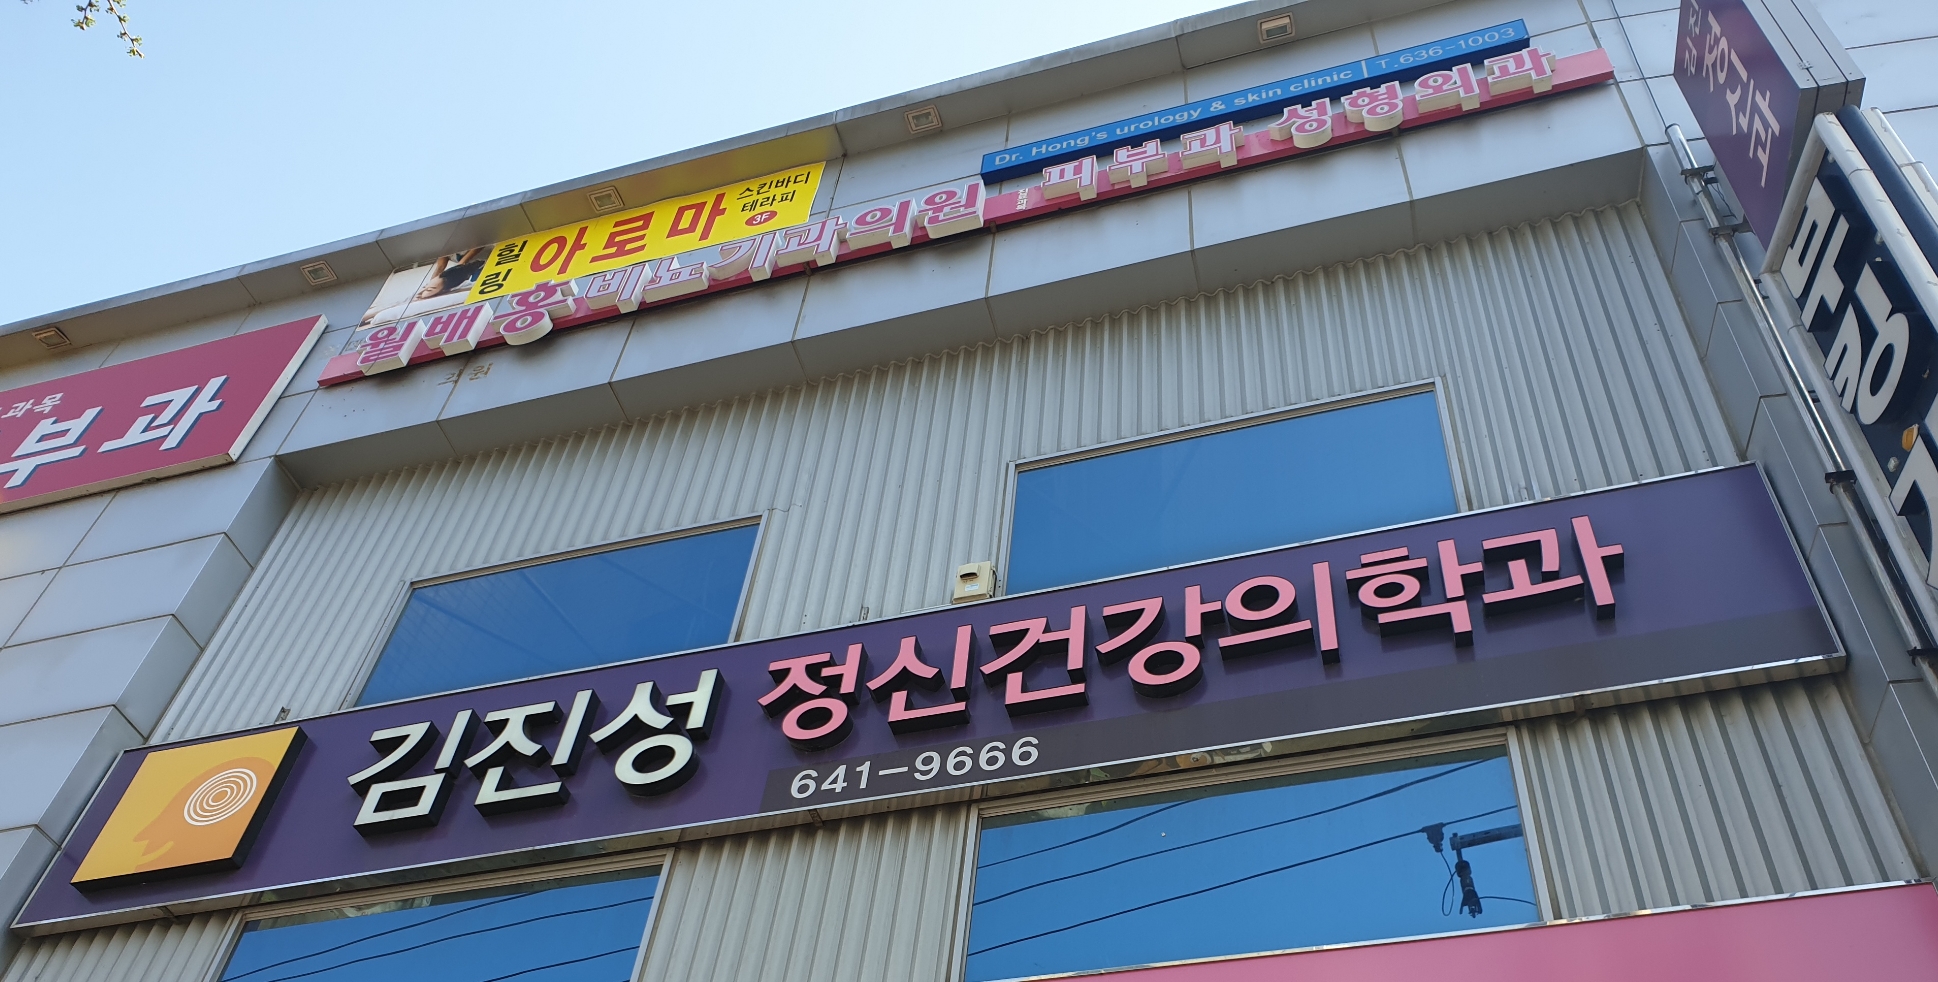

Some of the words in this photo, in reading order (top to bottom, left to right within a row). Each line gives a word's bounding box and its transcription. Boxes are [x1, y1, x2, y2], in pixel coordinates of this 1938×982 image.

[994, 151, 1023, 167] Dr.
[1031, 130, 1108, 157] Hong's
[1115, 106, 1203, 135] urology
[1209, 100, 1226, 113] &
[1233, 86, 1282, 107] skin
[1289, 69, 1353, 94] clinic
[1041, 121, 1243, 194] 피부과
[1268, 46, 1555, 140] 성형외과
[1702, 10, 1781, 189] 정신과
[736, 171, 811, 201] 스킨바디
[740, 189, 796, 213] 테라피
[752, 211, 771, 225] 3F
[478, 239, 529, 296] 힐링
[529, 192, 727, 276] 아로마
[347, 668, 721, 831] 김진성
[757, 515, 1624, 743] 정신건강의학과
[789, 735, 1039, 800] 641-9666
